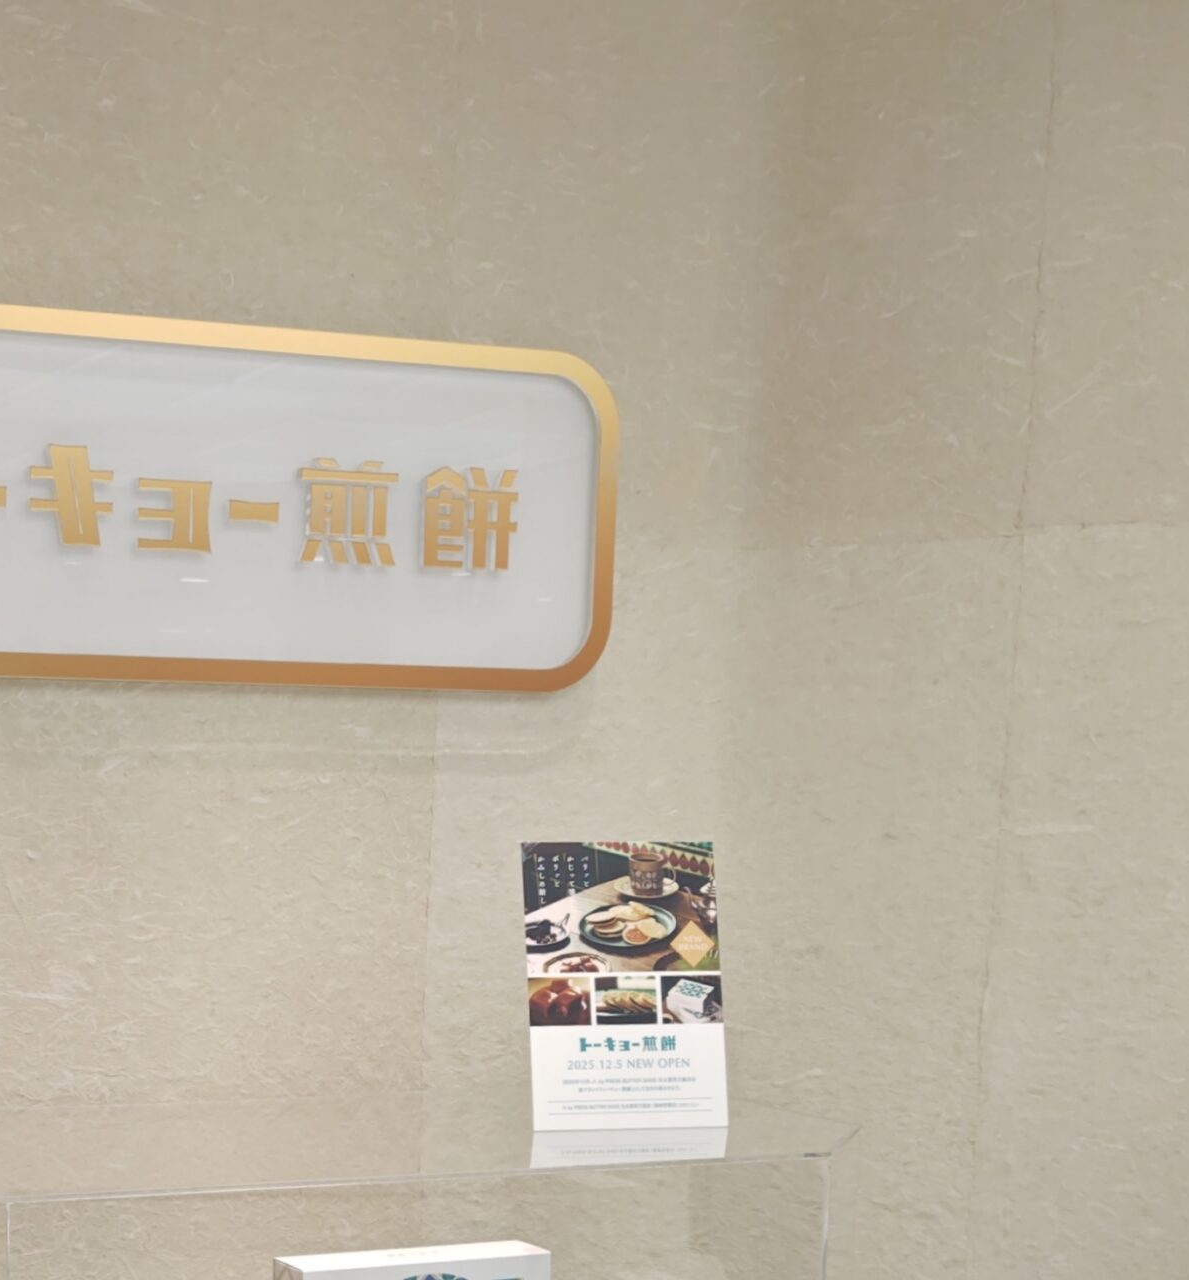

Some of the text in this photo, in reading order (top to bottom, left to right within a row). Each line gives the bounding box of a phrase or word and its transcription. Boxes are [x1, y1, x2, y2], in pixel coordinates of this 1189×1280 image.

[579, 1035, 676, 1052] トーキョー煎餅
[567, 1057, 691, 1070] 2025.12.5 NEW OPEN
